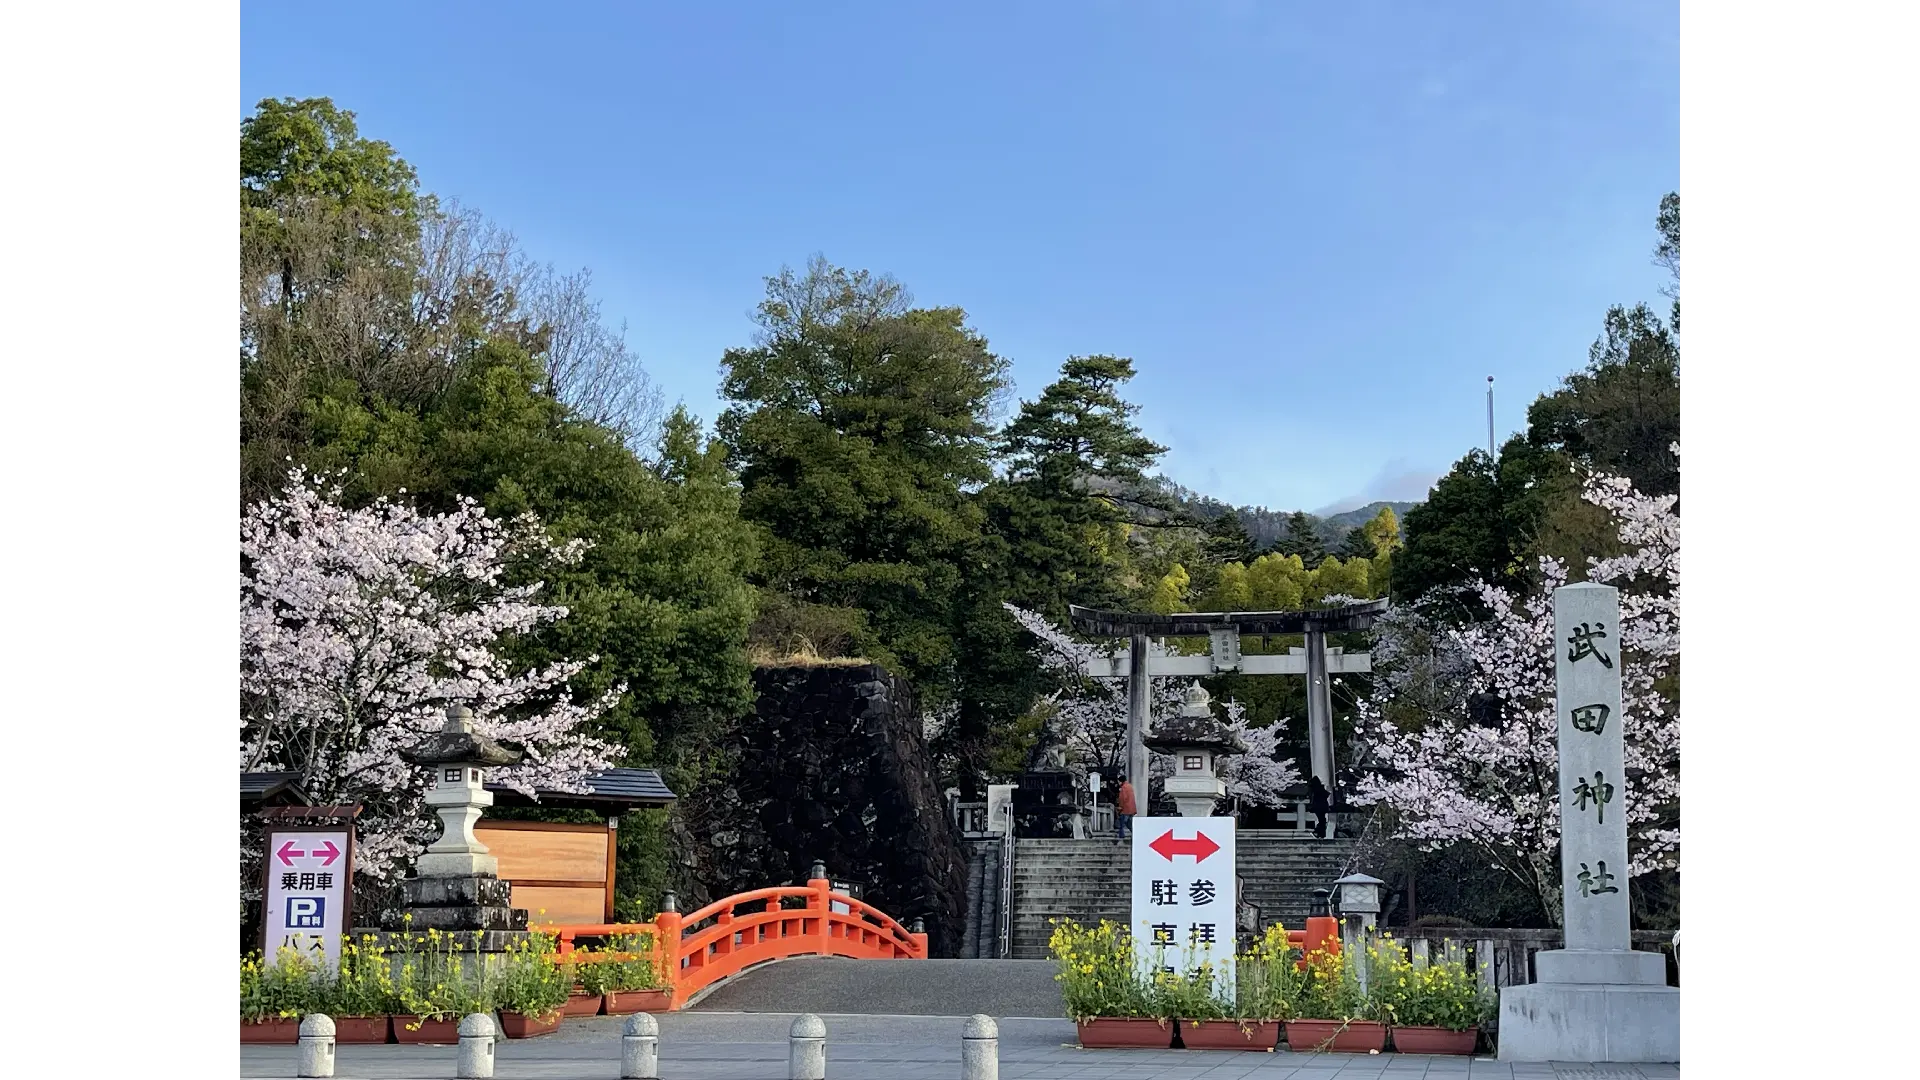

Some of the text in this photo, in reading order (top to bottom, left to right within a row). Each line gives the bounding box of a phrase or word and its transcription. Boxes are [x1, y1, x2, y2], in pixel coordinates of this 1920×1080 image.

[1567, 622, 1619, 898] 武田神社
[281, 872, 333, 891] 乗用車
[290, 899, 317, 926] P
[1150, 879, 1178, 987] 駐車
